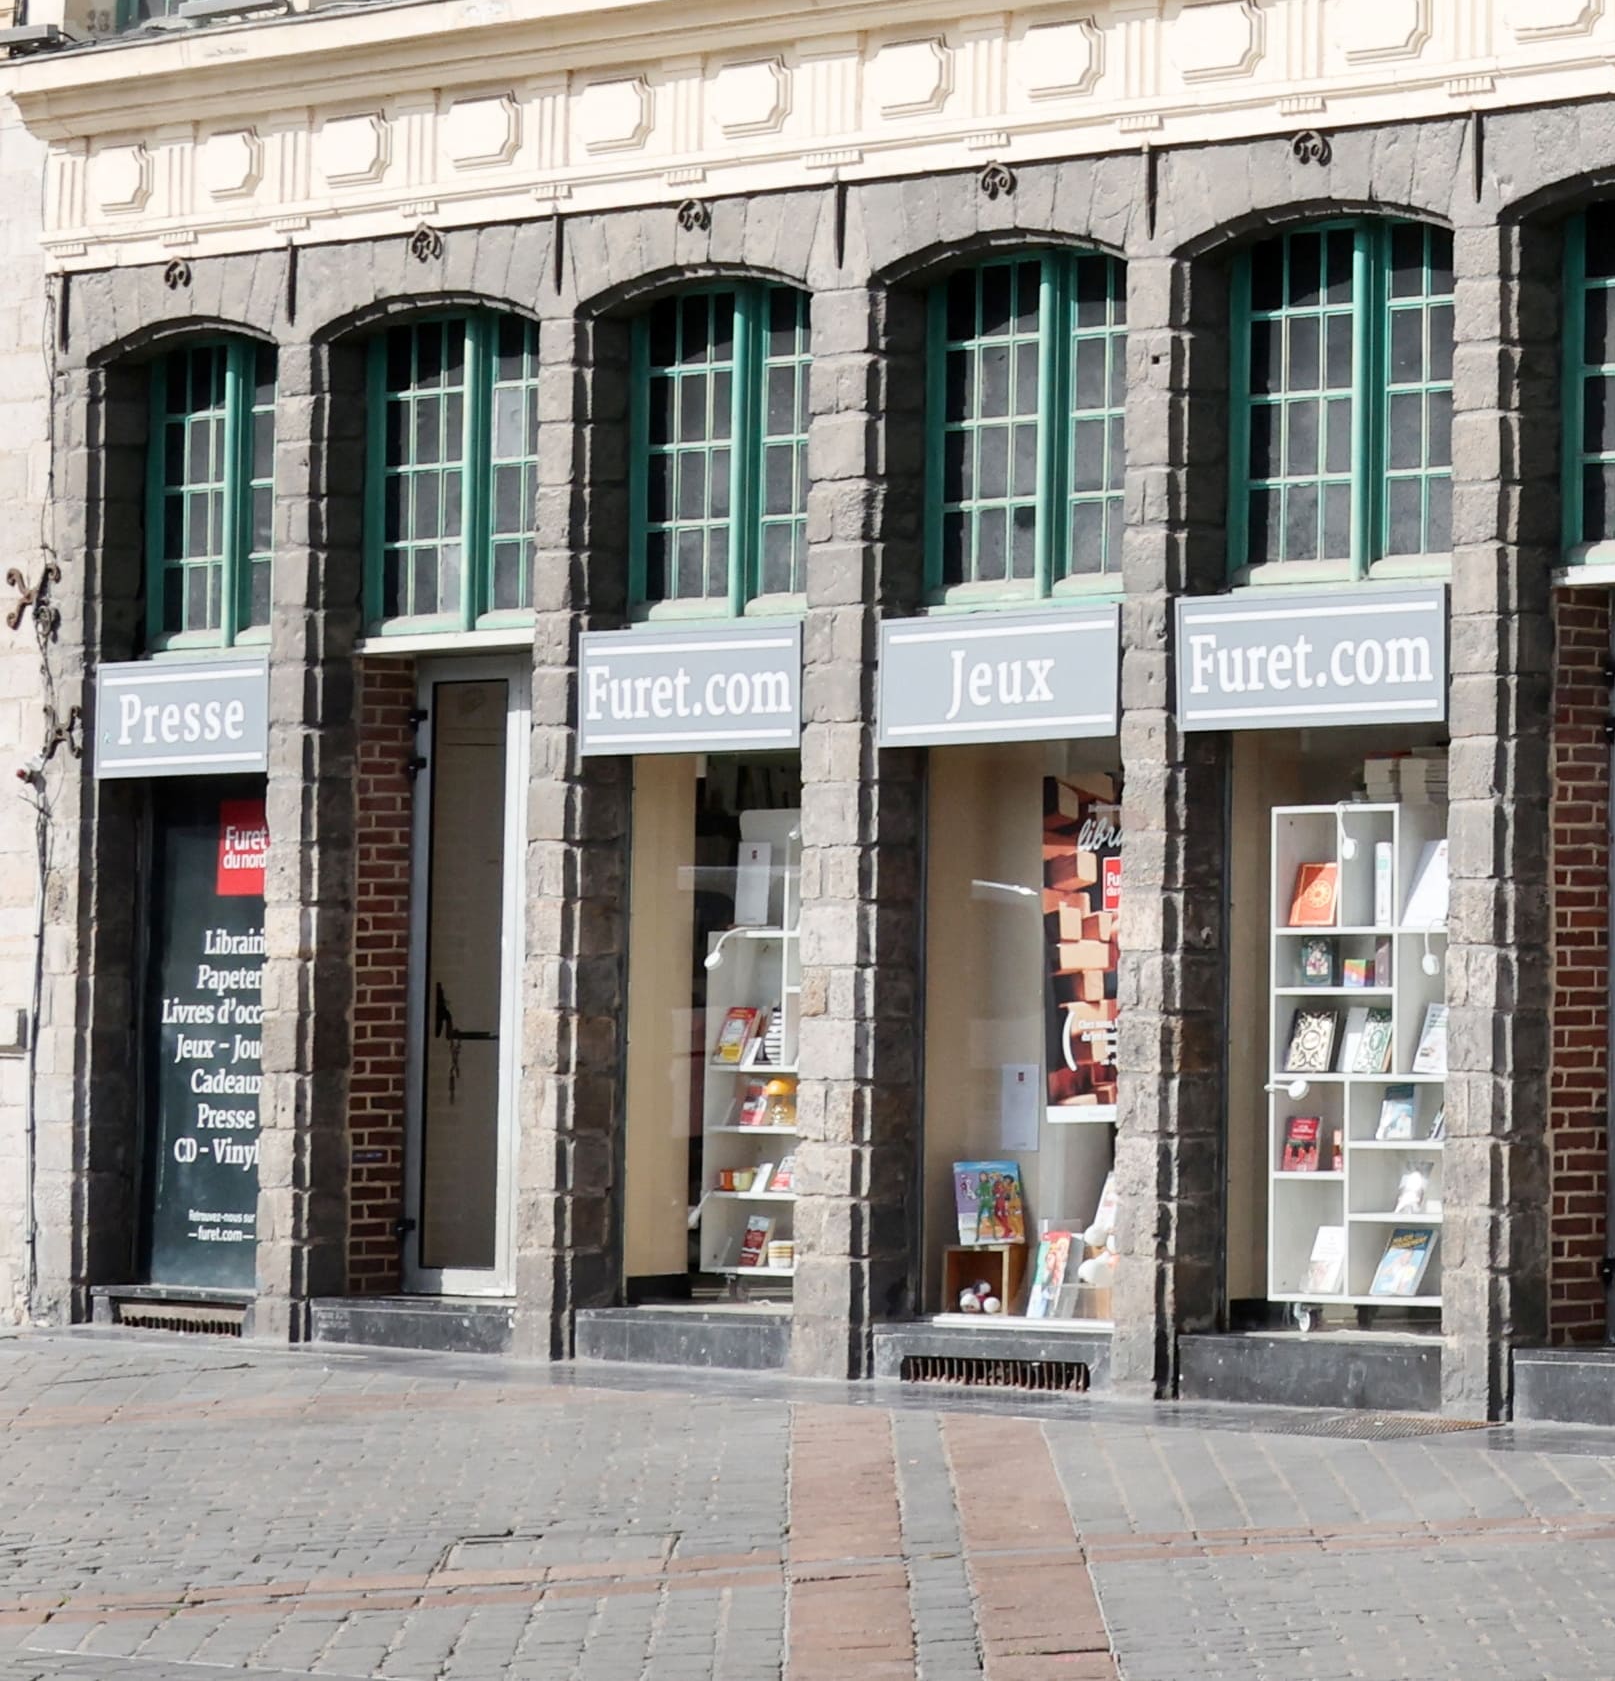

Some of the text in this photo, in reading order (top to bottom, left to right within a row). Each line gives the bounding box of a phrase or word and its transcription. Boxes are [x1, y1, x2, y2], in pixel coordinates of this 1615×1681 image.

[1188, 634, 1434, 694] Furet.com
[585, 665, 793, 721] Furet.com
[945, 649, 1056, 720] Jeux
[118, 693, 244, 745] Presse
[225, 826, 268, 851] Furet
[195, 962, 265, 997] Papeter
[161, 997, 215, 1024] Livres
[174, 1033, 216, 1064] Jeux
[230, 1034, 263, 1064] Jou
[196, 1103, 256, 1130] Presse
[173, 1137, 198, 1163] CD
